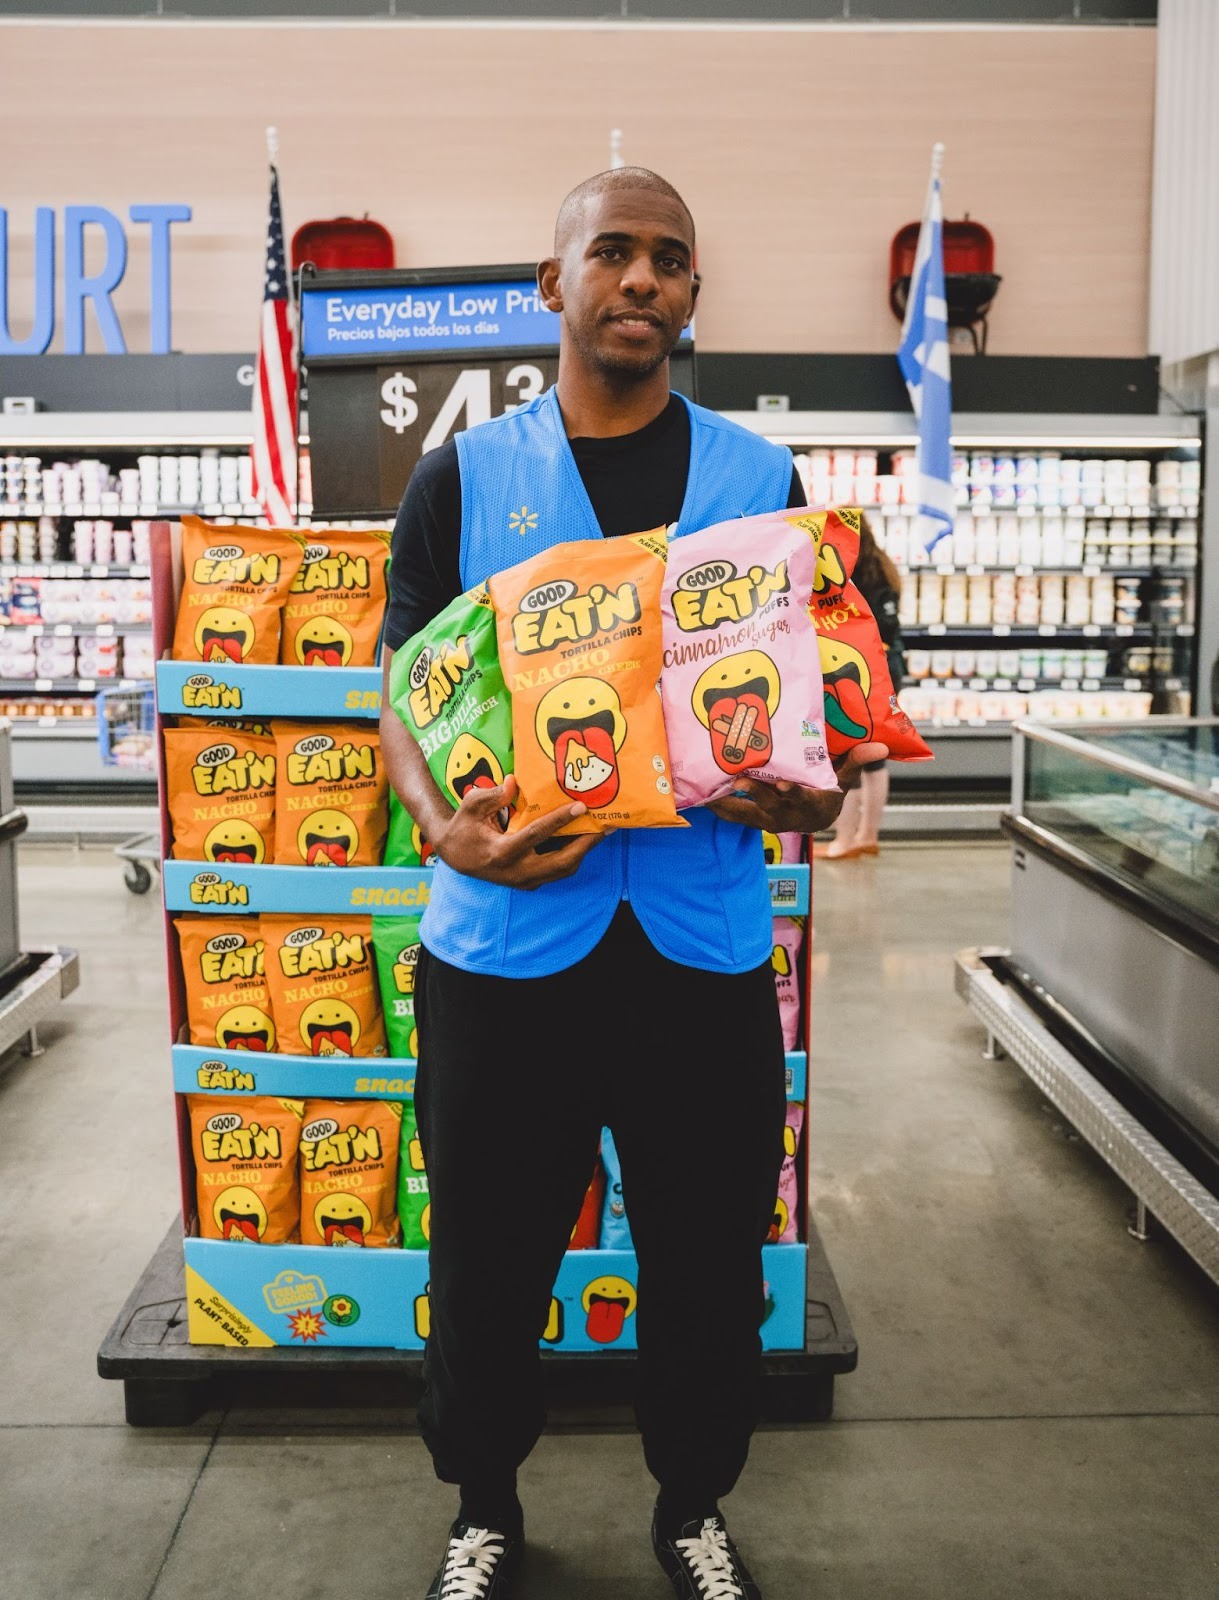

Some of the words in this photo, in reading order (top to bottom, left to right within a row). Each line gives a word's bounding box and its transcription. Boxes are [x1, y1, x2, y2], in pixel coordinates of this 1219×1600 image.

[0, 205, 191, 354] URT
[327, 295, 441, 325] Everyday
[449, 293, 497, 316] Low
[506, 290, 550, 314] Pric
[328, 327, 374, 341] Precios
[378, 326, 410, 342] bajos
[413, 324, 449, 338] todos
[453, 323, 470, 336] los
[209, 548, 237, 558] GOOD
[304, 547, 323, 560] OOD
[192, 553, 281, 586] EAT'N
[686, 565, 726, 587] GOOD
[188, 593, 252, 607] NACHO
[316, 593, 350, 601] TORTILLA
[527, 584, 566, 608] GOOD
[671, 559, 791, 633] EAT'N
[285, 600, 348, 618] NACHO
[759, 596, 790, 619] PUFFS
[820, 602, 860, 631] HOT
[511, 582, 642, 656] EAT'N
[560, 636, 611, 659] TORTILLA
[613, 626, 642, 641] CHIPS
[751, 619, 791, 647] sugar
[663, 622, 755, 668] cinnamon
[413, 653, 429, 684] GOOD
[512, 649, 610, 692] NACHO
[190, 677, 210, 686] GOOD
[408, 635, 475, 730] EAT'N
[182, 682, 243, 709] EAT'N
[445, 689, 465, 721] TORTILLA
[463, 669, 483, 692] CHIPS
[418, 720, 452, 761] BIG
[450, 693, 478, 736] DILL
[203, 747, 230, 763] GOOD
[301, 738, 327, 752] GOOD
[191, 750, 276, 797] EAT'N
[286, 743, 376, 786] EAT'N
[226, 792, 258, 803] TORTILLA
[259, 790, 275, 798] CHIP
[318, 784, 354, 793] TORTILLA
[355, 780, 377, 789] CHIPS
[193, 800, 257, 822] NACHO
[286, 792, 353, 811] NACHO
[199, 875, 216, 883] GOOD
[190, 880, 249, 906] EAT'N
[350, 881, 431, 906] snack
[212, 937, 238, 950] GOOD
[291, 929, 317, 944] GOOD
[278, 931, 367, 978] EAT'N
[404, 947, 420, 962] GO
[234, 980, 265, 989] TORTILLA
[313, 972, 347, 982] TORTILLA
[349, 965, 369, 976] CHIPS
[776, 978, 791, 988] FFS
[202, 988, 266, 1010] NACHO
[283, 979, 348, 1004] NACHO
[393, 999, 414, 1017] BI
[197, 1068, 256, 1091] EAT'N
[355, 1077, 415, 1093] snac
[212, 1117, 236, 1130] GOOD
[306, 1122, 332, 1138] GOOD
[201, 1122, 282, 1162] EAT'N
[299, 1124, 382, 1172] EAT'N
[202, 1170, 262, 1187] NACHO
[328, 1167, 362, 1177] TORTILLA
[364, 1163, 384, 1171] CHIPS
[405, 1176, 429, 1194] BI
[195, 1298, 249, 1346] PLANT-BASED
[209, 1296, 252, 1334] Surprisingly
